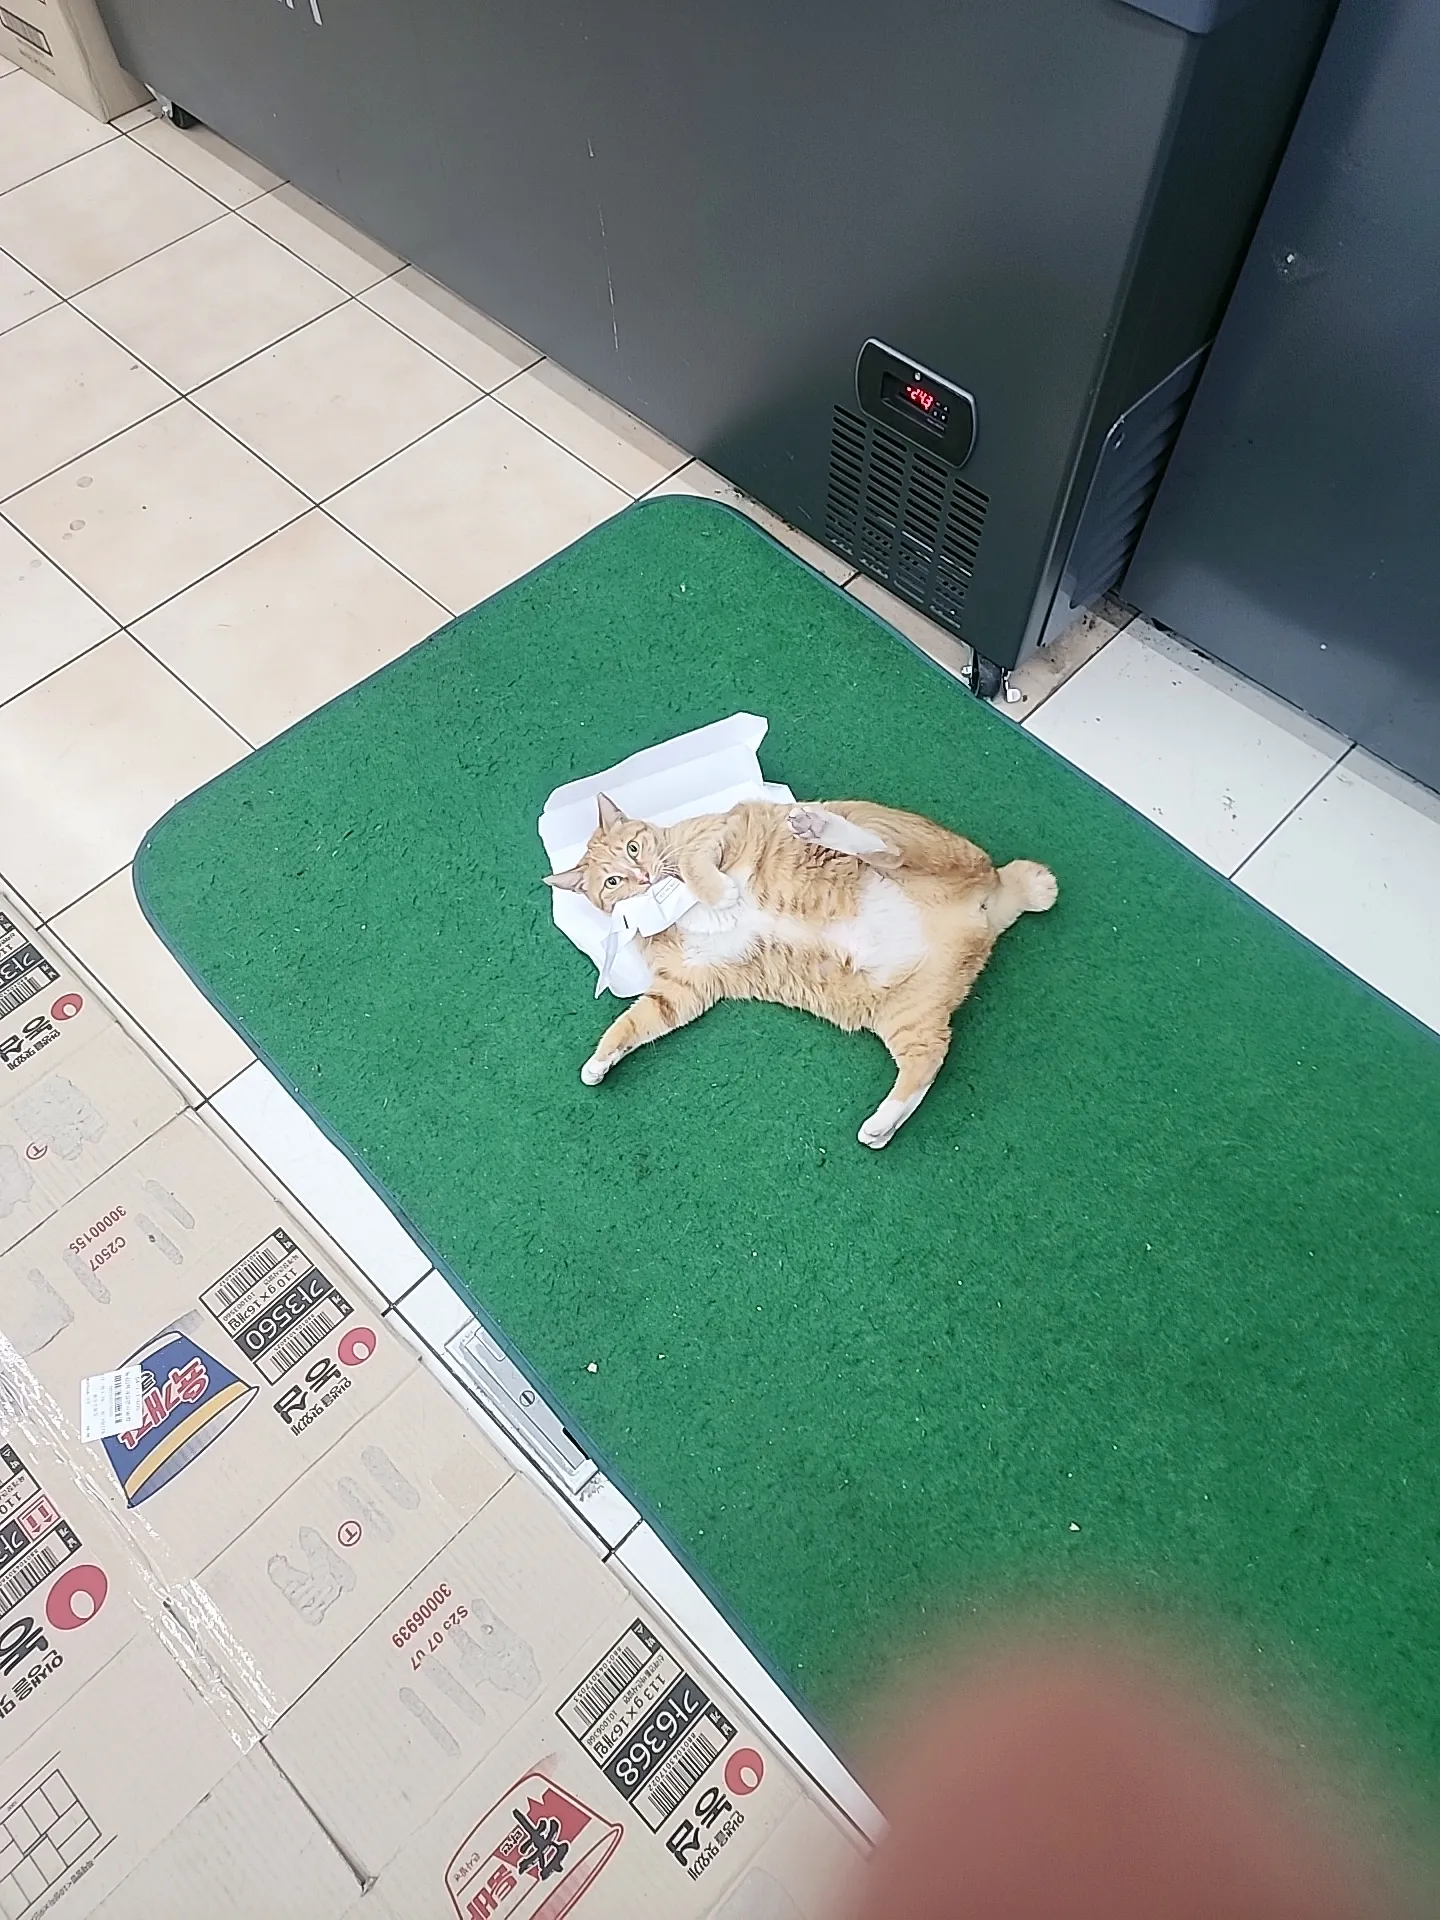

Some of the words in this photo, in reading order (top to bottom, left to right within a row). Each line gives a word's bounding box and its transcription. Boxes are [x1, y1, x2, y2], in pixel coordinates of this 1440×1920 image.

[89, 1236, 126, 1272] C2507
[280, 1269, 298, 1286] 110
[246, 1280, 323, 1350] 가3560
[273, 1358, 341, 1424] 농심
[320, 1377, 352, 1406] 인생을
[290, 1403, 324, 1436] 맛있게
[392, 1583, 452, 1648] 30006939
[427, 1632, 443, 1652] 07
[12, 1650, 64, 1701] 인생을
[643, 1675, 665, 1700] 113
[586, 1711, 617, 1745] 101006368
[616, 1690, 699, 1786] 가6368
[666, 1787, 733, 1867] 농심
[715, 1811, 745, 1847] 인생을
[687, 1842, 720, 1881] 맛있게
